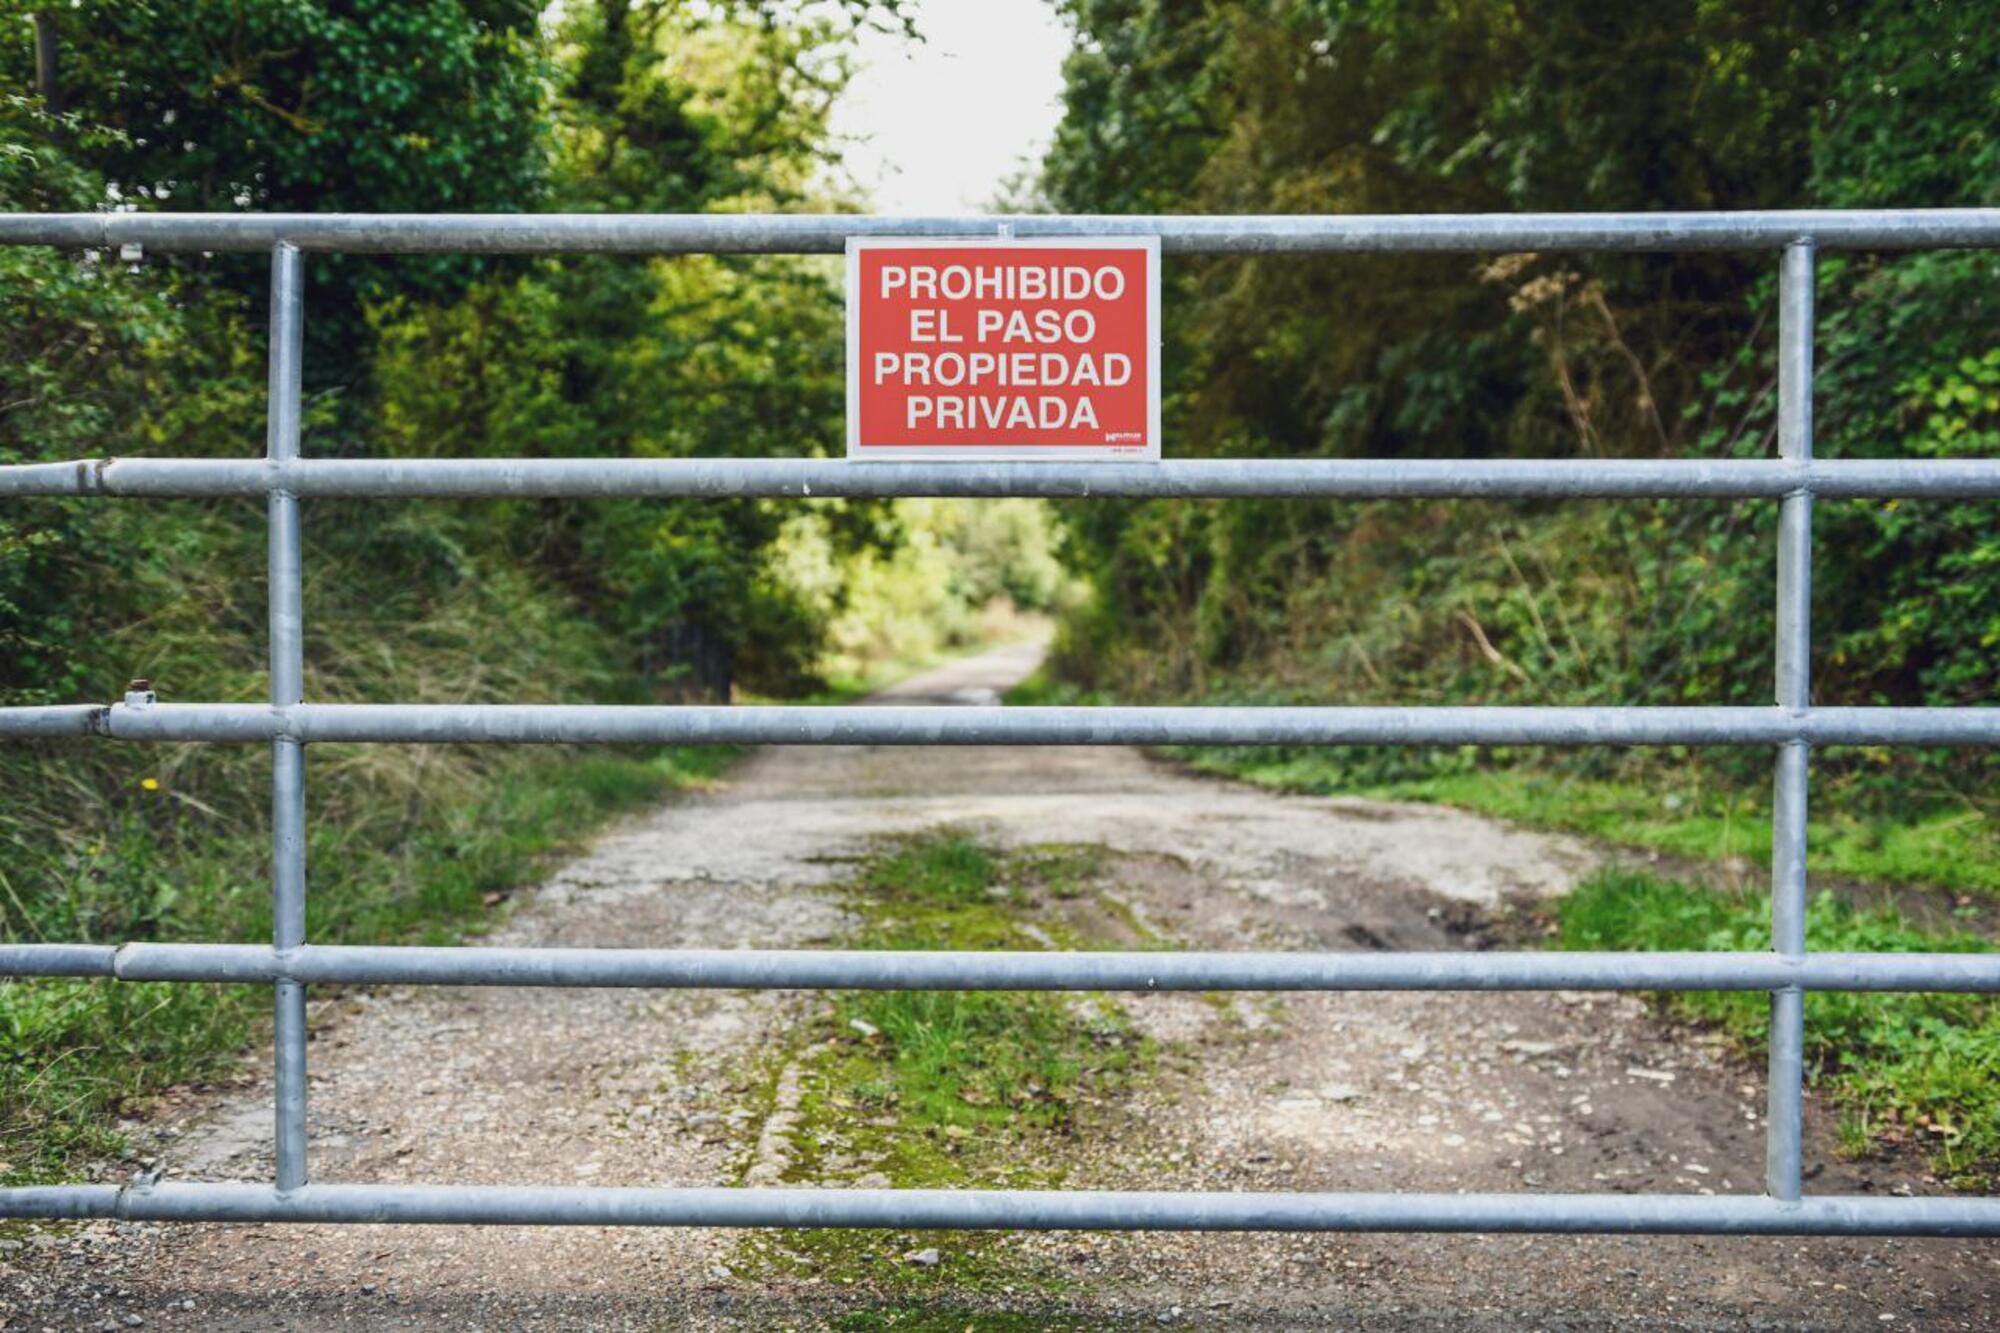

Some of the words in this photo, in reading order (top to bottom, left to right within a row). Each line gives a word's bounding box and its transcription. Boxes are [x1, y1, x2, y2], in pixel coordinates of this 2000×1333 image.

[881, 265, 1125, 300] PROHIBIDO
[910, 309, 963, 342] EL
[977, 309, 1096, 343] PASO
[874, 352, 1132, 386] PROPIEDAD
[907, 396, 1099, 430] PRIVADA
